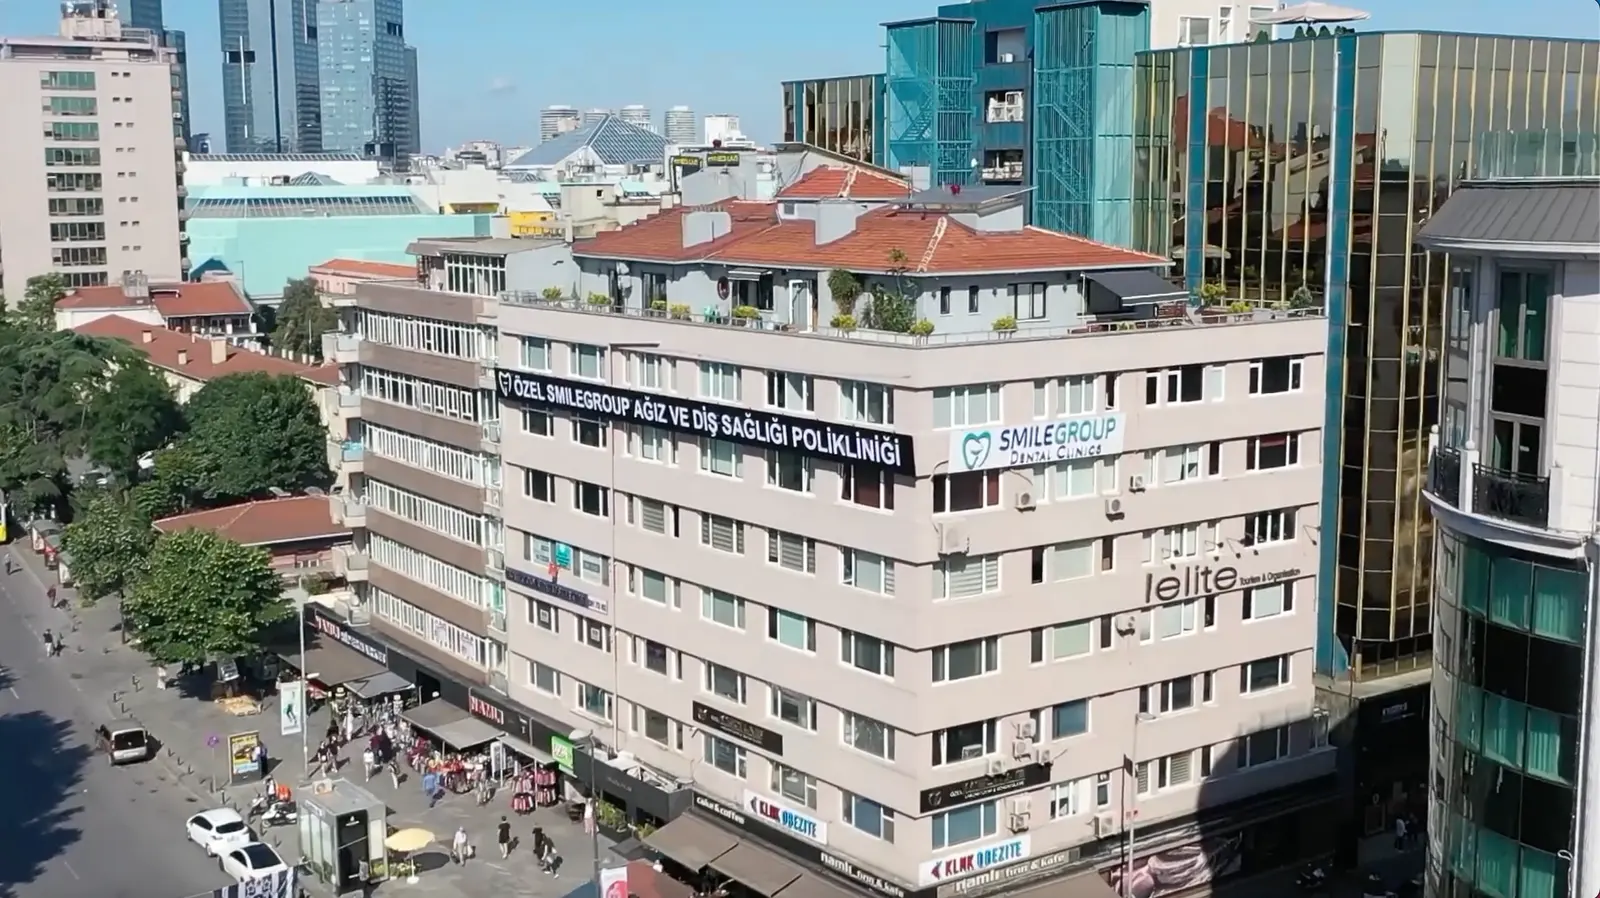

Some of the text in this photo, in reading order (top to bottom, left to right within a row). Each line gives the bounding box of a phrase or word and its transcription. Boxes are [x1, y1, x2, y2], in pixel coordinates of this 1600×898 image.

[514, 374, 901, 466] ÖZEL SMILEGROUP AĞIZ VE DİŞ SAĞLIĞI POLİKLİNİĞİ
[999, 416, 1117, 451] SMILEGROUP
[1030, 859, 1039, 871] &
